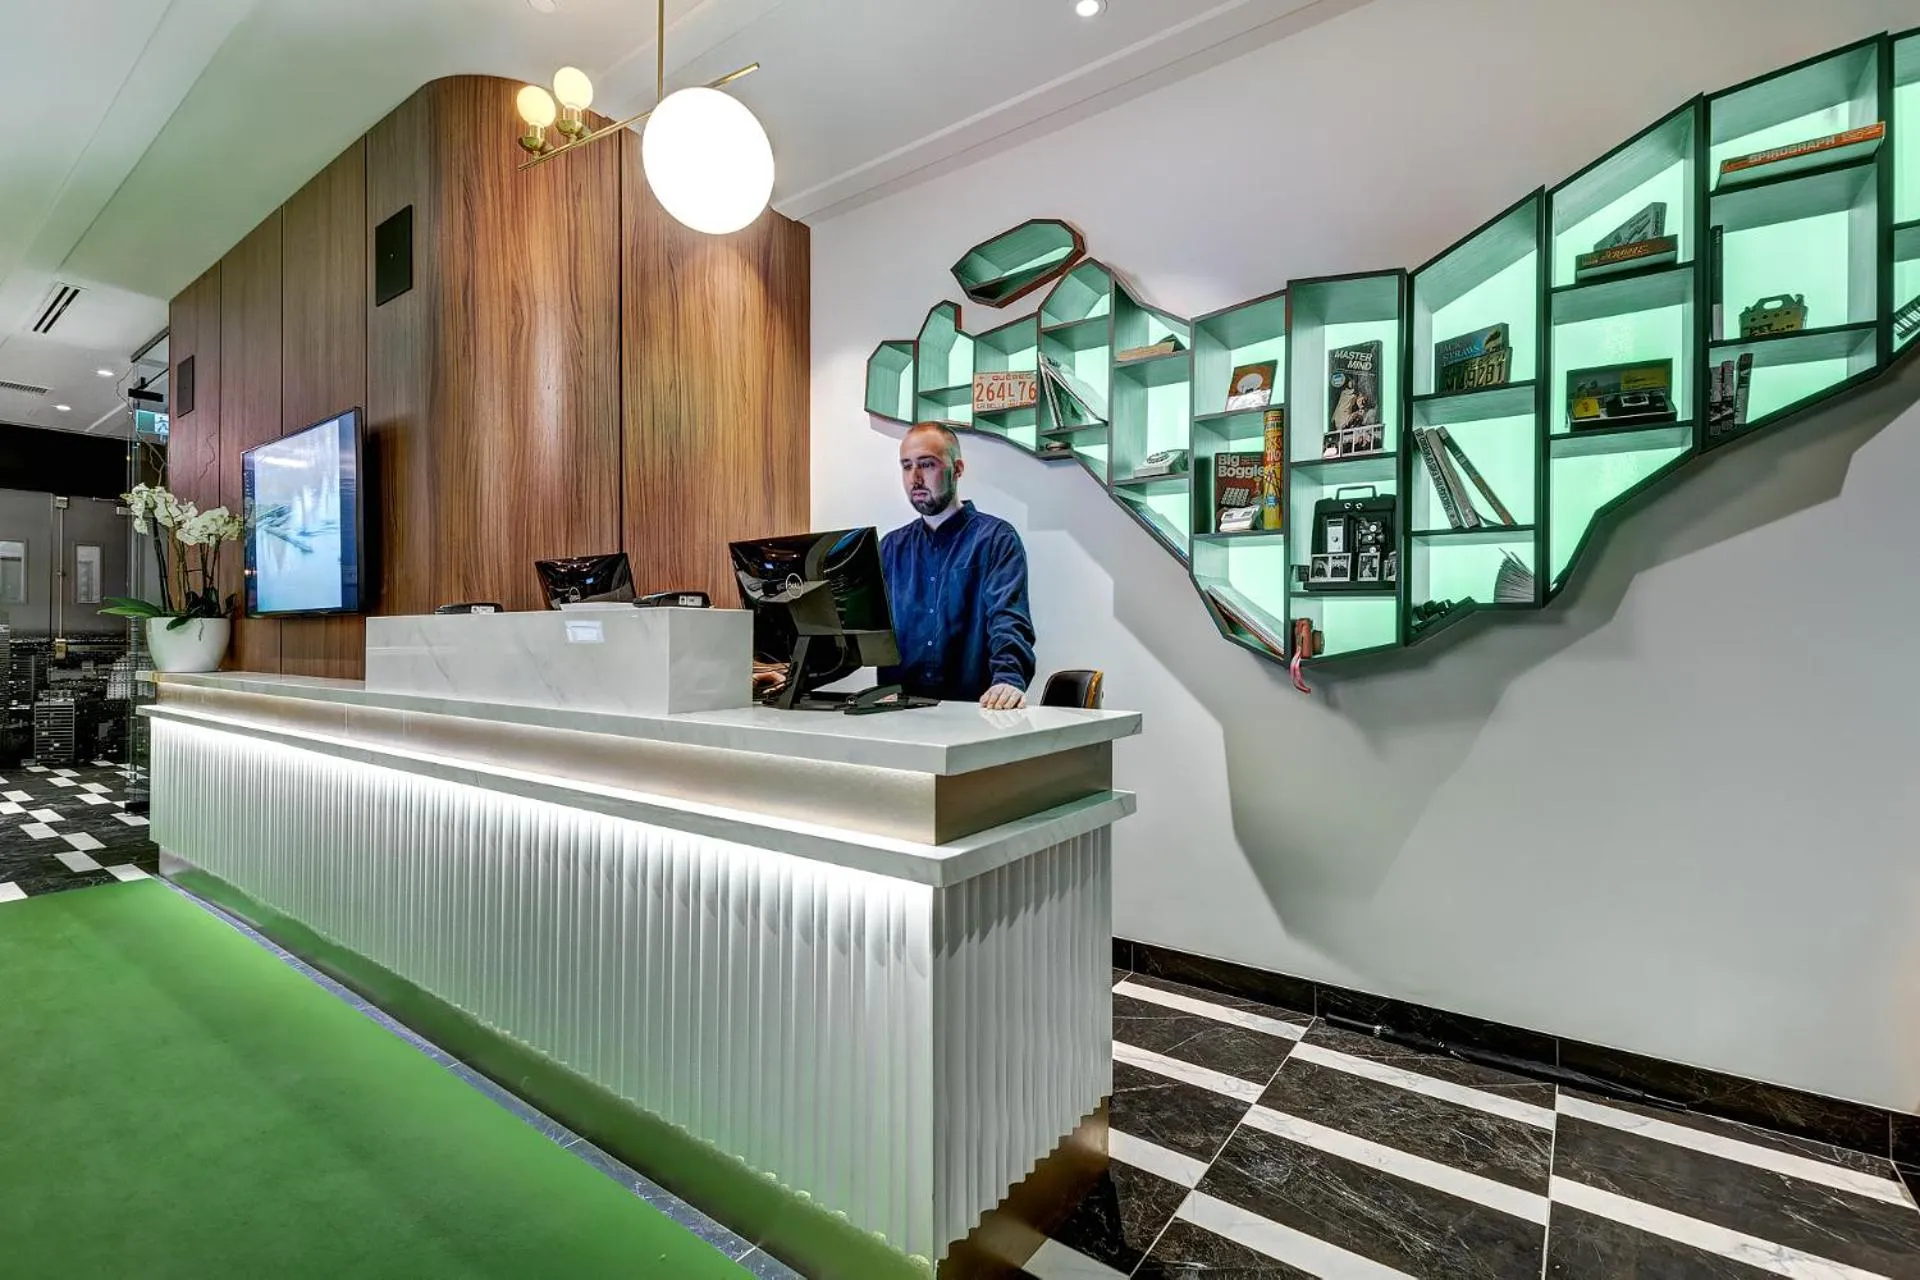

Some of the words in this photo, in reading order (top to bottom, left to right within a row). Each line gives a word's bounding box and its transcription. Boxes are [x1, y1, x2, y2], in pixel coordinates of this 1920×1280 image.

[1334, 350, 1373, 361] MASTER
[1347, 360, 1373, 371] MIND
[1218, 454, 1240, 467] Big
[1218, 464, 1264, 479] Boggle
